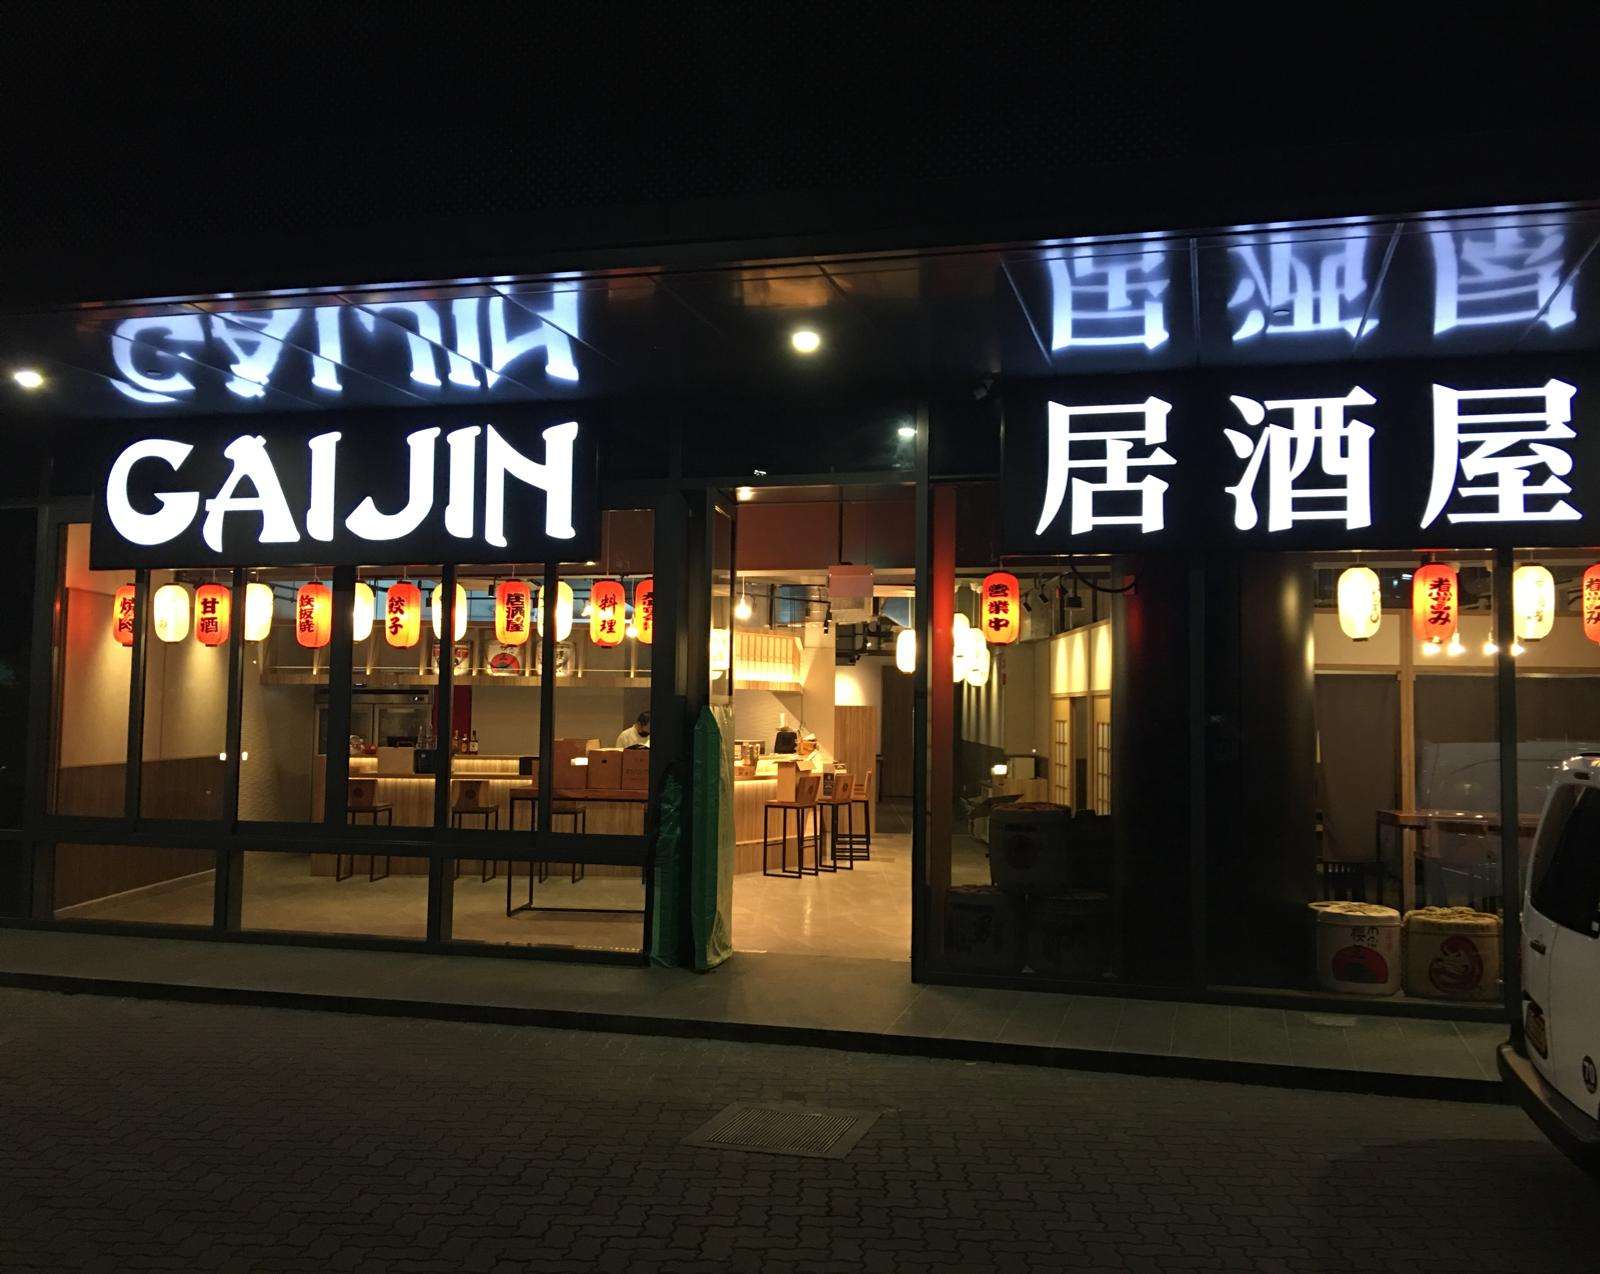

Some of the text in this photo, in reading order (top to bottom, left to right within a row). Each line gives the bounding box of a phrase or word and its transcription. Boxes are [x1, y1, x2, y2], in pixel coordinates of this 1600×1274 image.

[1036, 378, 1583, 536] 居酒屋
[106, 421, 579, 553] GAIJIN
[200, 597, 220, 634] 甘酒
[388, 596, 405, 636] 餃子
[505, 592, 525, 633] 居酒屋
[599, 592, 618, 634] 料理
